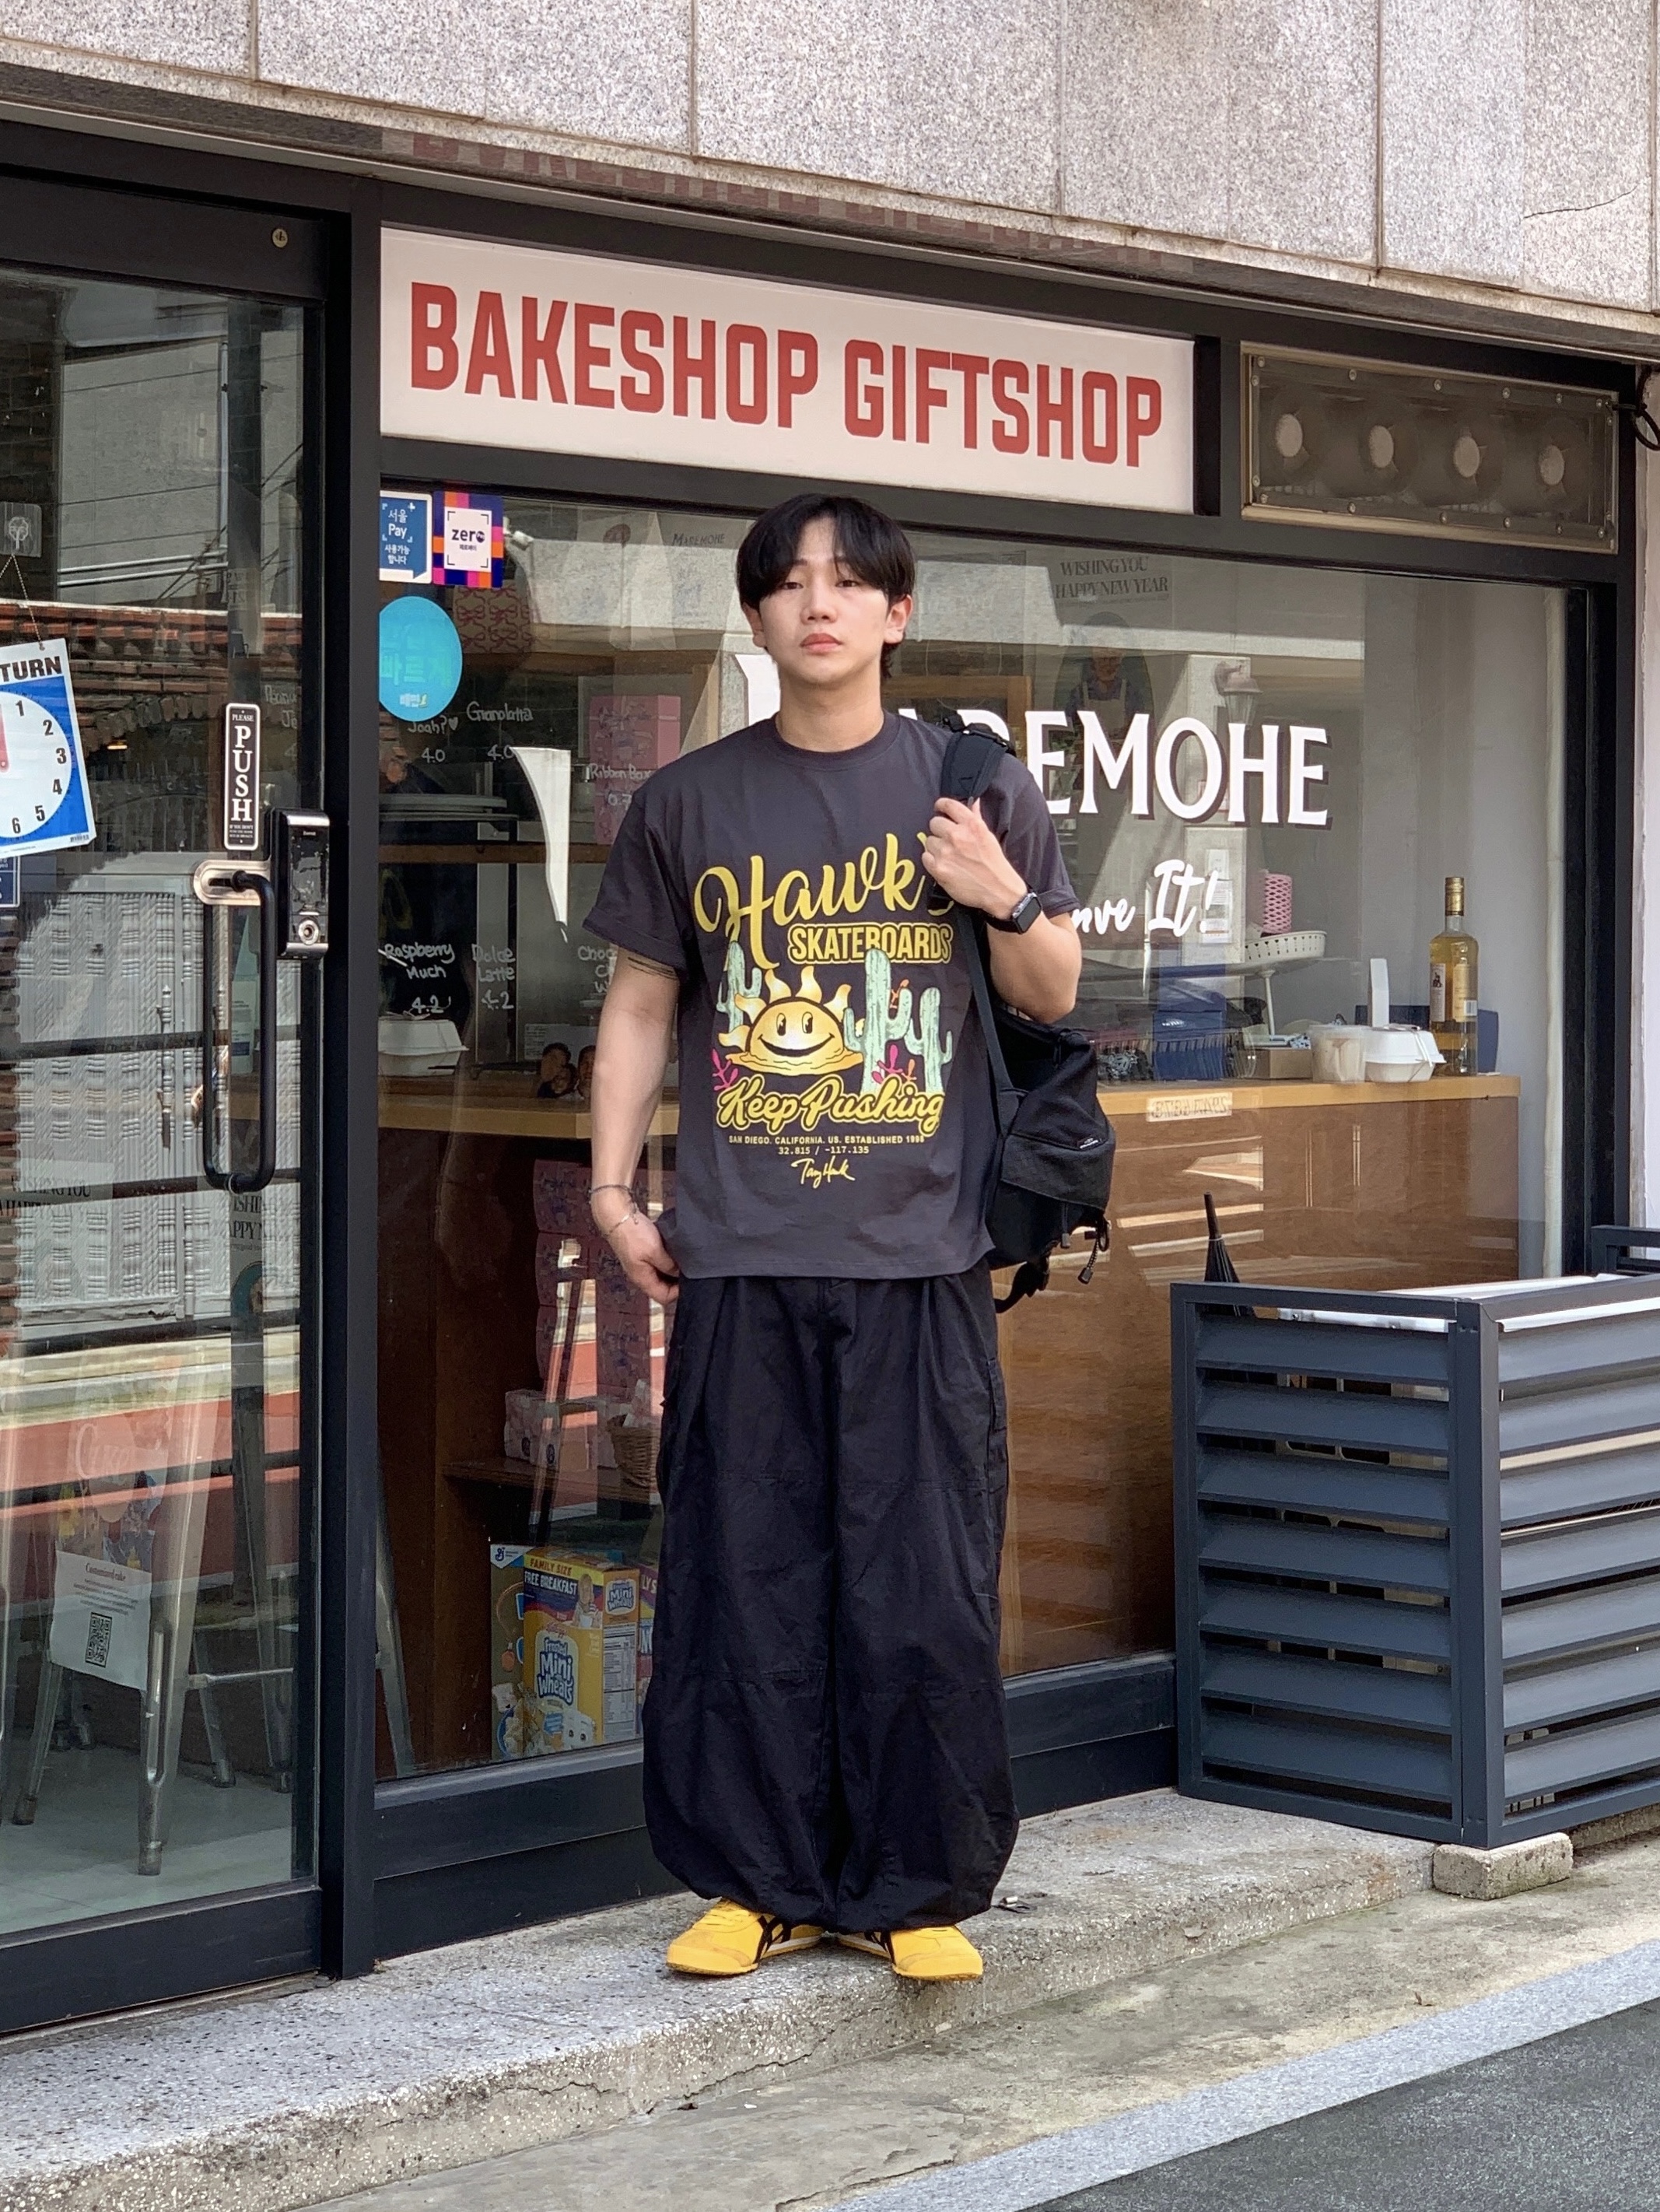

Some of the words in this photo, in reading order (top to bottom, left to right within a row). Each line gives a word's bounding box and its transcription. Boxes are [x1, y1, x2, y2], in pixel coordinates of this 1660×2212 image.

[411, 281, 818, 429] BAKESHOP
[843, 338, 1162, 468] GIFTSHOP
[388, 509, 408, 523] 서울
[388, 524, 407, 539] Pay
[15, 699, 25, 717] 1
[232, 713, 254, 722] PLEASE
[42, 719, 54, 736] 2
[56, 748, 67, 765] 3
[230, 724, 253, 822] PUSH
[53, 779, 63, 795] 4
[35, 805, 46, 822] 5
[12, 818, 22, 835] 6
[788, 924, 954, 964] SKATEBOARDS
[716, 1073, 800, 1135] Keep
[800, 1073, 945, 1138] Pushing
[728, 1135, 743, 1145] SAN
[844, 1135, 903, 1145] ESTABLISHED
[778, 1146, 811, 1155] 32.815
[530, 1558, 555, 1572] FAMILY
[556, 1565, 573, 1576] SIZE
[524, 1571, 540, 1587] FREE
[540, 1572, 578, 1596] BREAKFAST
[540, 1652, 573, 1683] Mini
[537, 1674, 574, 1705] Wheats
